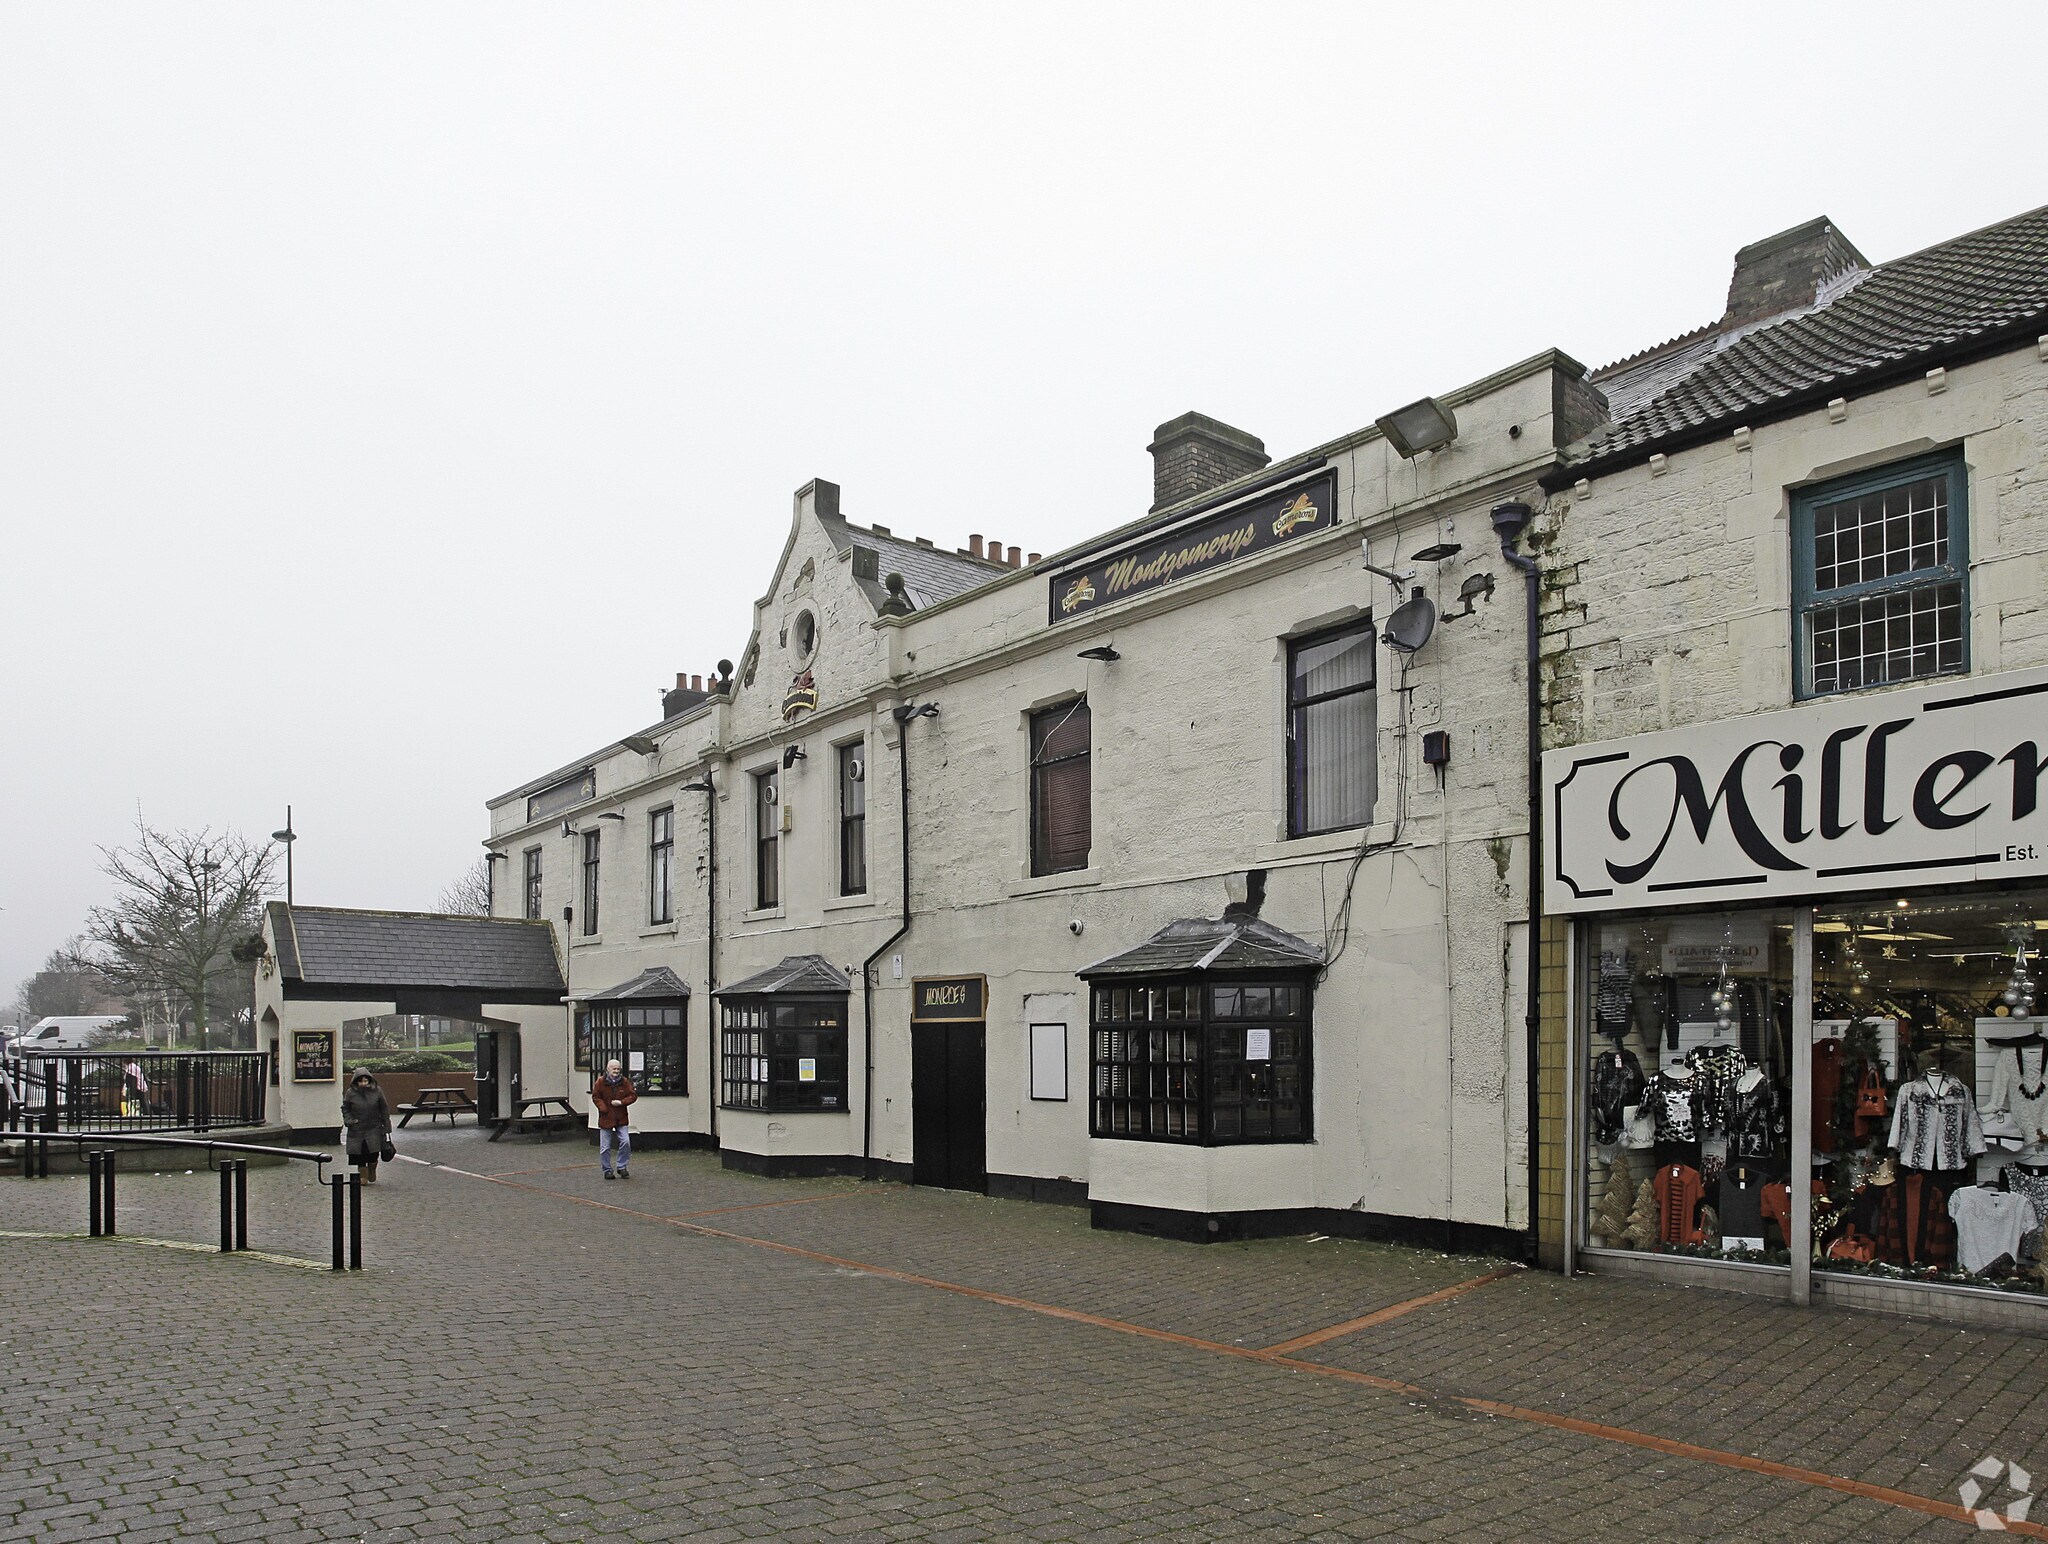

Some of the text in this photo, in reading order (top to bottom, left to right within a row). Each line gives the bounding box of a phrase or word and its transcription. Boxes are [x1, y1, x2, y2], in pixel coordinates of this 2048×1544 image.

[1275, 509, 1314, 530] Camerons
[1104, 522, 1256, 595] Montgomerys
[2005, 844, 2039, 861] Est.
